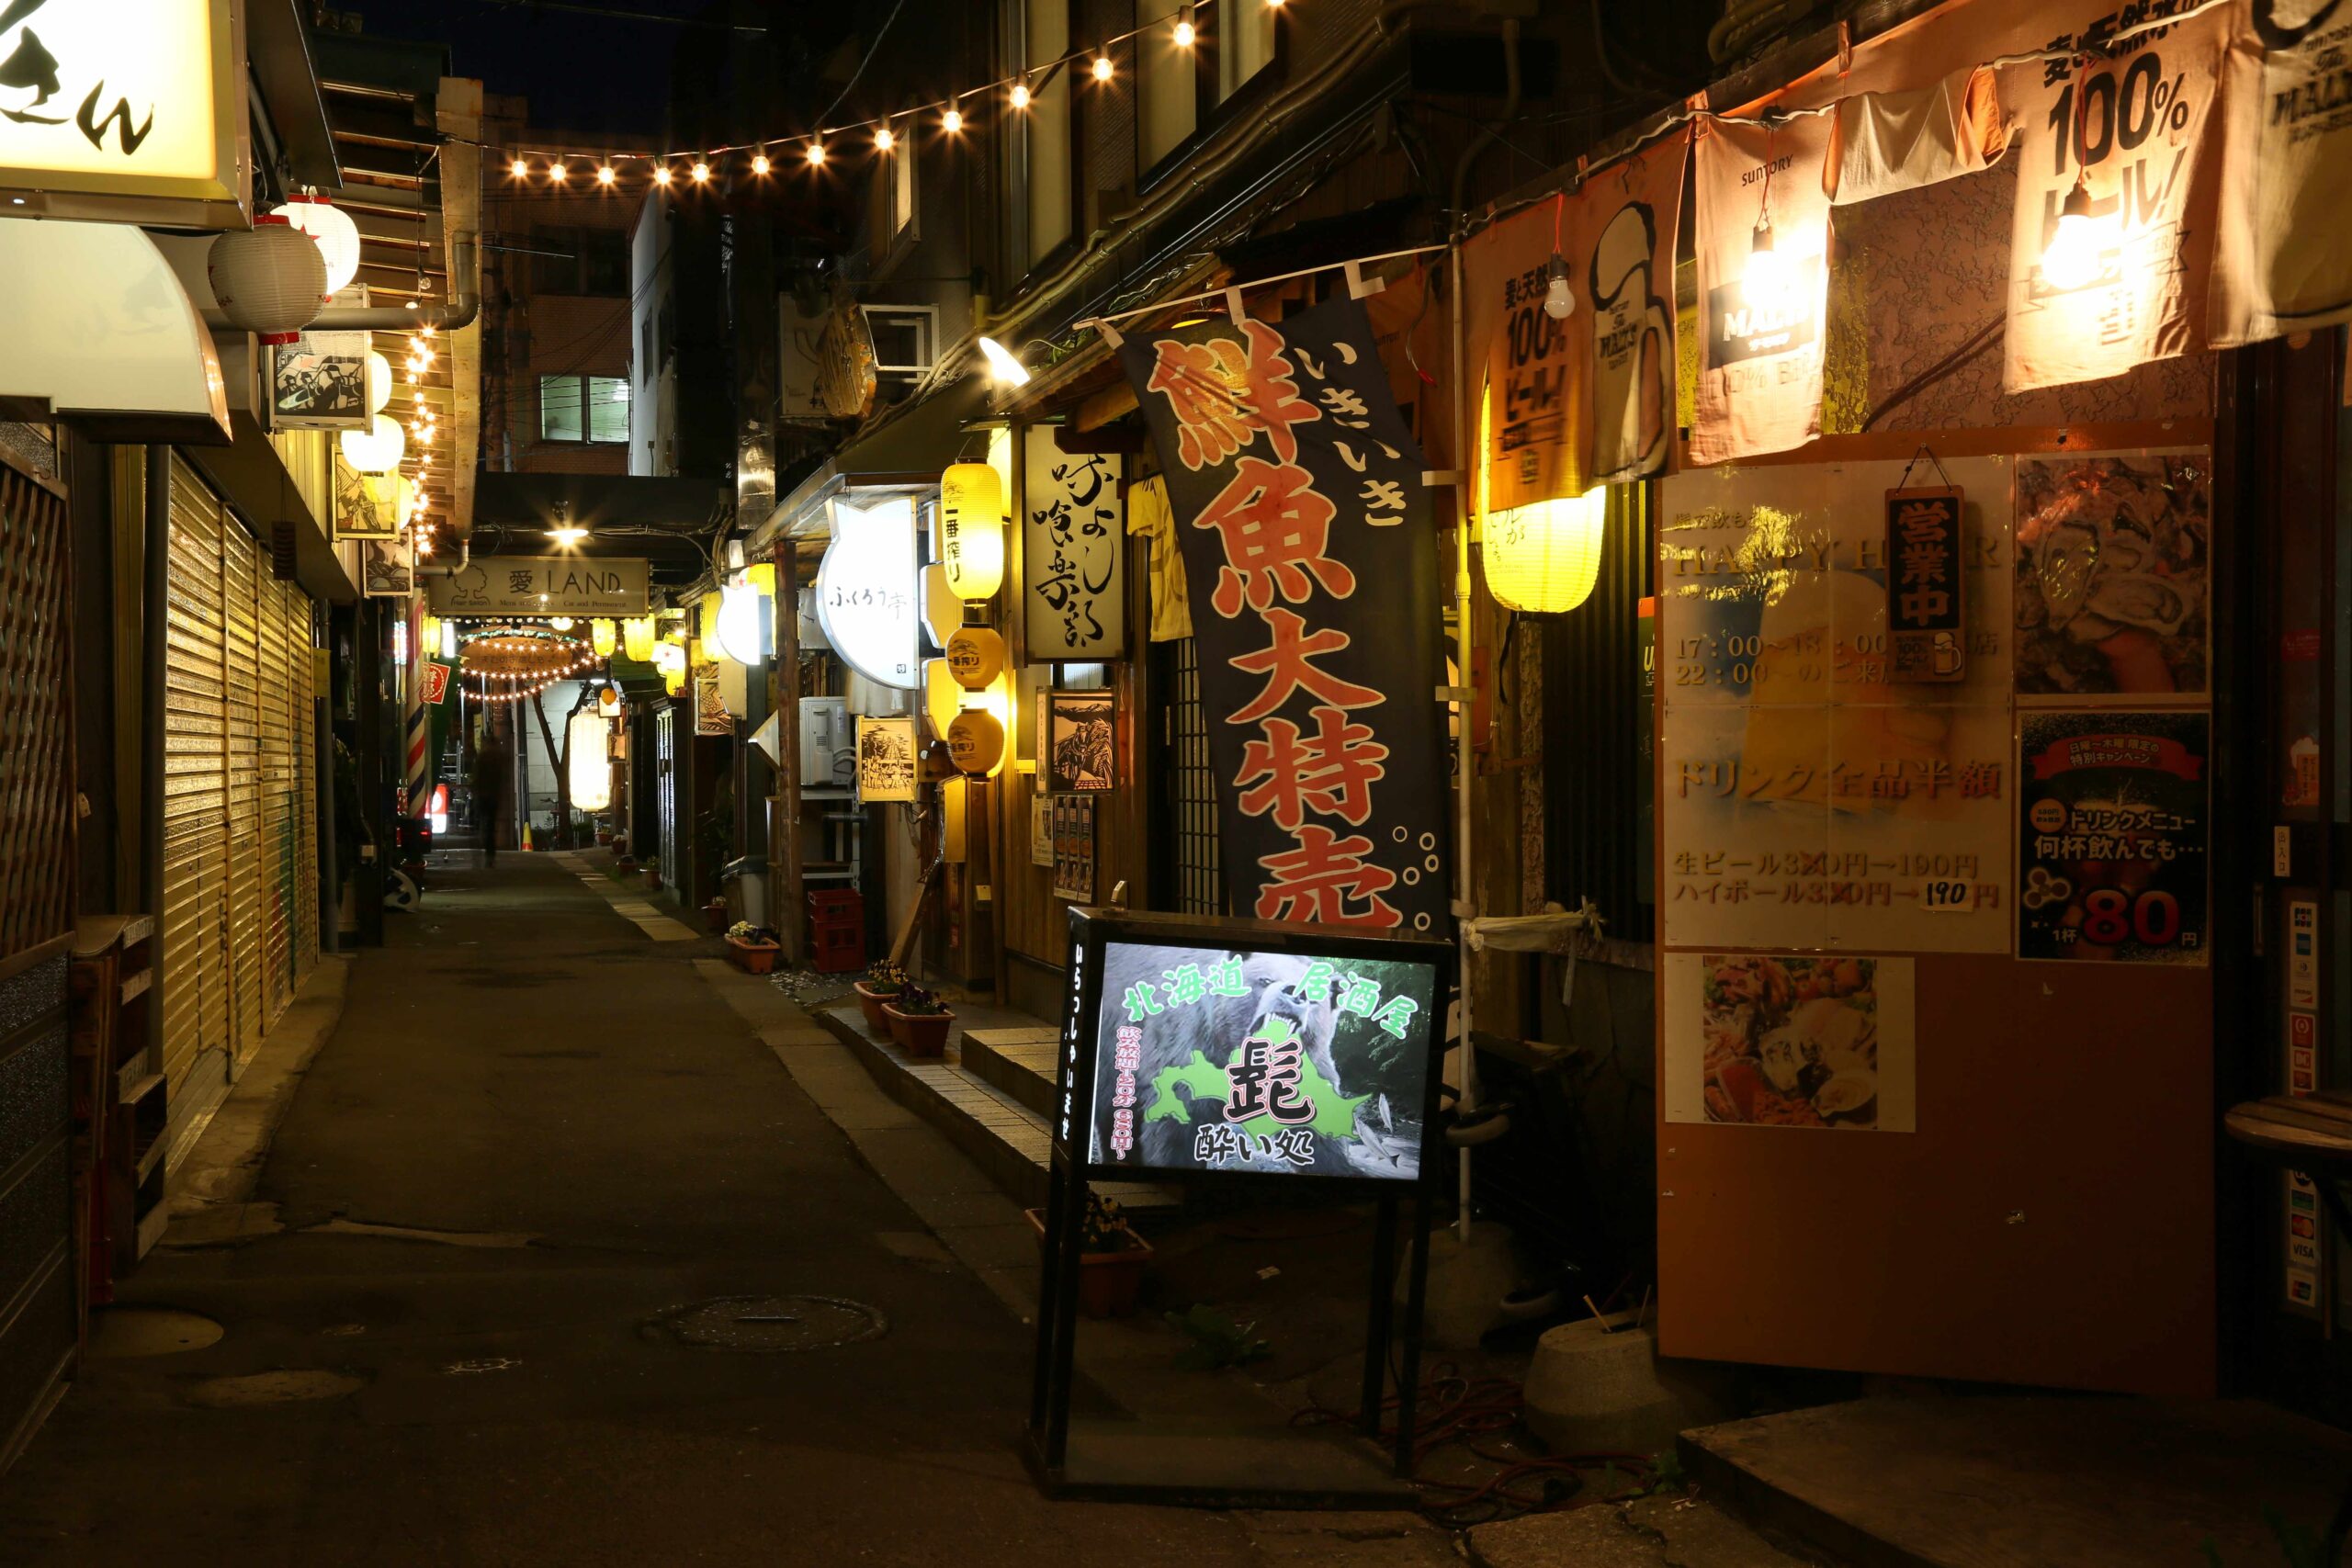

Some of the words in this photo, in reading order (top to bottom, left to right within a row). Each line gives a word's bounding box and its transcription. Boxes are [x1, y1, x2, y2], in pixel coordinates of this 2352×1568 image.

[2048, 52, 2188, 176] 100%
[1294, 342, 1407, 527] いきいき
[944, 508, 961, 583] 一番搾り
[1896, 499, 1952, 627] 営業中
[508, 569, 533, 594] 愛
[547, 569, 623, 596] LAND
[829, 586, 907, 620] ふくろう亭
[1148, 317, 1403, 928] 鮮魚大特売
[1675, 758, 2001, 800] ドリンク全品半額
[2070, 810, 2197, 831] ドリンクメニュー
[2278, 829, 2288, 872] 出入口
[2052, 929, 2078, 945] 1杯
[2082, 888, 2181, 946] 80
[2181, 932, 2198, 947] 円
[1122, 954, 1252, 1021] 北海道
[1293, 962, 1419, 1039] 居酒屋
[1062, 943, 1083, 1141] いらっしゃいませ
[1224, 1036, 1316, 1123] 髭
[1194, 1123, 1315, 1164] 酔い処
[2292, 1243, 2314, 1259] VISA
